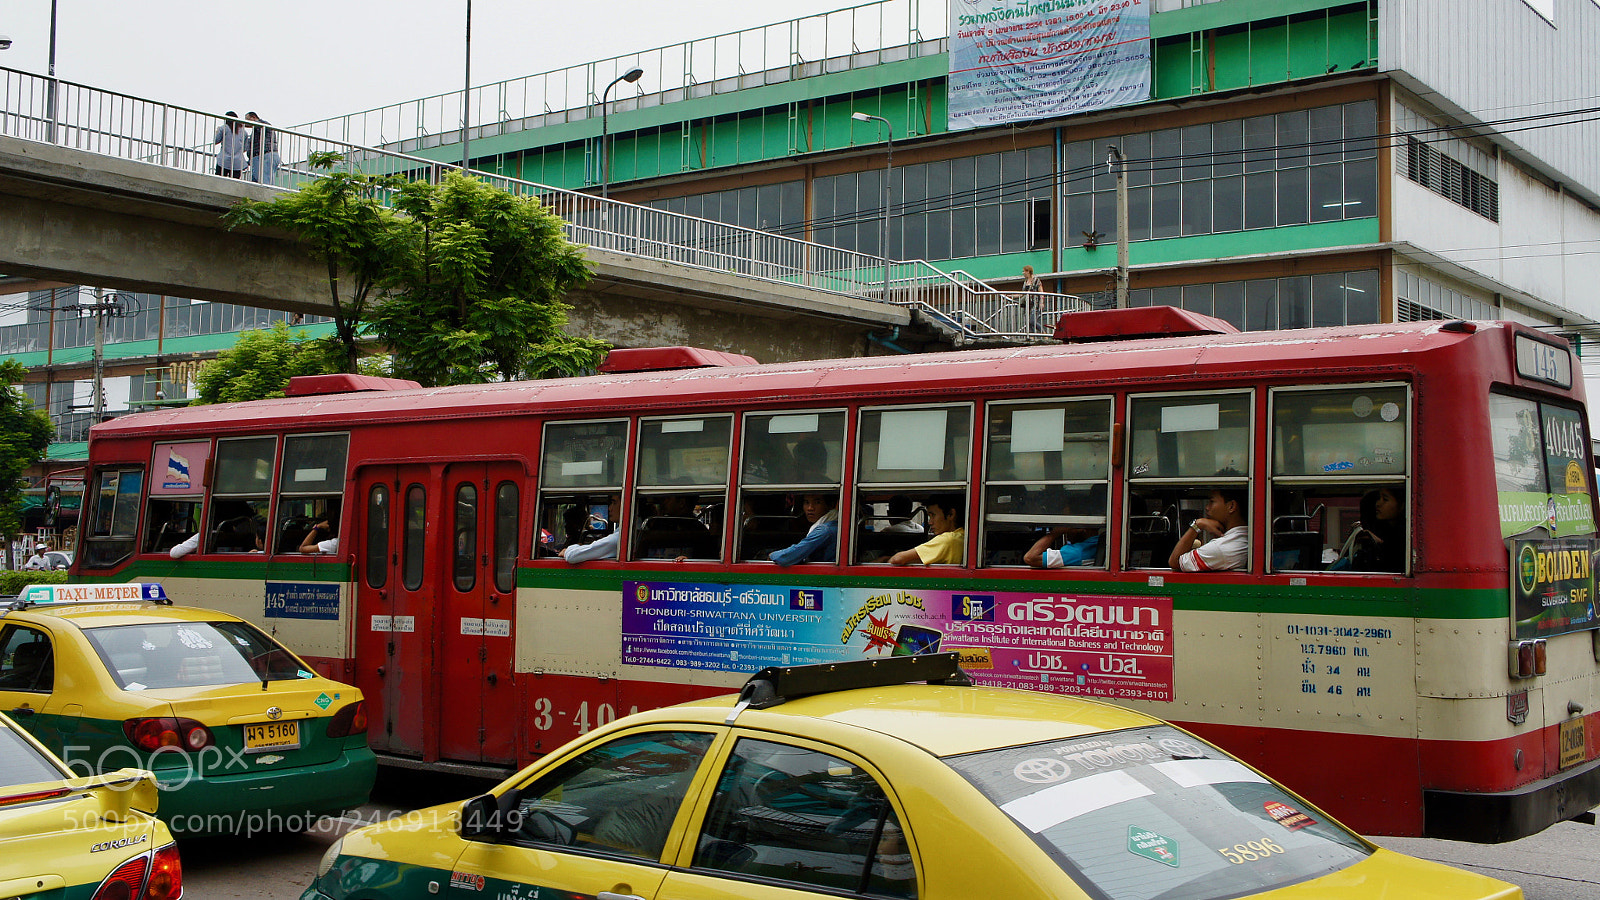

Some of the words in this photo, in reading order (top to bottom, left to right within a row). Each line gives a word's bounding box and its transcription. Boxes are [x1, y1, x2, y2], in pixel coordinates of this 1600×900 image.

[1533, 343, 1557, 380] 145
[1546, 416, 1584, 460] 40445
[1537, 550, 1589, 583] BOLIDEN
[56, 587, 88, 600] TAXI
[95, 586, 139, 599] METER
[266, 592, 285, 608] 145
[651, 588, 785, 606] มหาวิทยาลัยธนบุรี-ศรีวัฒนา
[1570, 588, 1588, 603] SMF
[635, 607, 756, 621] THONBURI-SRIWATTANA
[759, 612, 823, 623] UNIVERSITY
[841, 593, 892, 644] สมัครเรียน
[1007, 596, 1159, 626] ศรีวัฒนา
[945, 621, 1164, 641] บริหารธุรกิจและเทคโนโลยีนานาชาติ
[943, 633, 979, 643] Sriwattana
[981, 634, 1010, 645] Institute
[1011, 635, 1020, 645] of
[1022, 636, 1066, 648] International
[1068, 638, 1101, 649] Business
[1103, 641, 1118, 650] and
[1120, 641, 1164, 654] Technology
[1028, 651, 1068, 670] ปวช.
[1099, 655, 1143, 674] ปวส.
[1326, 665, 1341, 675] 34
[1108, 687, 1168, 699] 0-2393-8101
[1327, 685, 1343, 695] 46
[268, 723, 296, 738] 5160
[91, 833, 148, 853] COROLLA
[1218, 837, 1285, 864] 5896
[451, 870, 477, 884] NITTO
